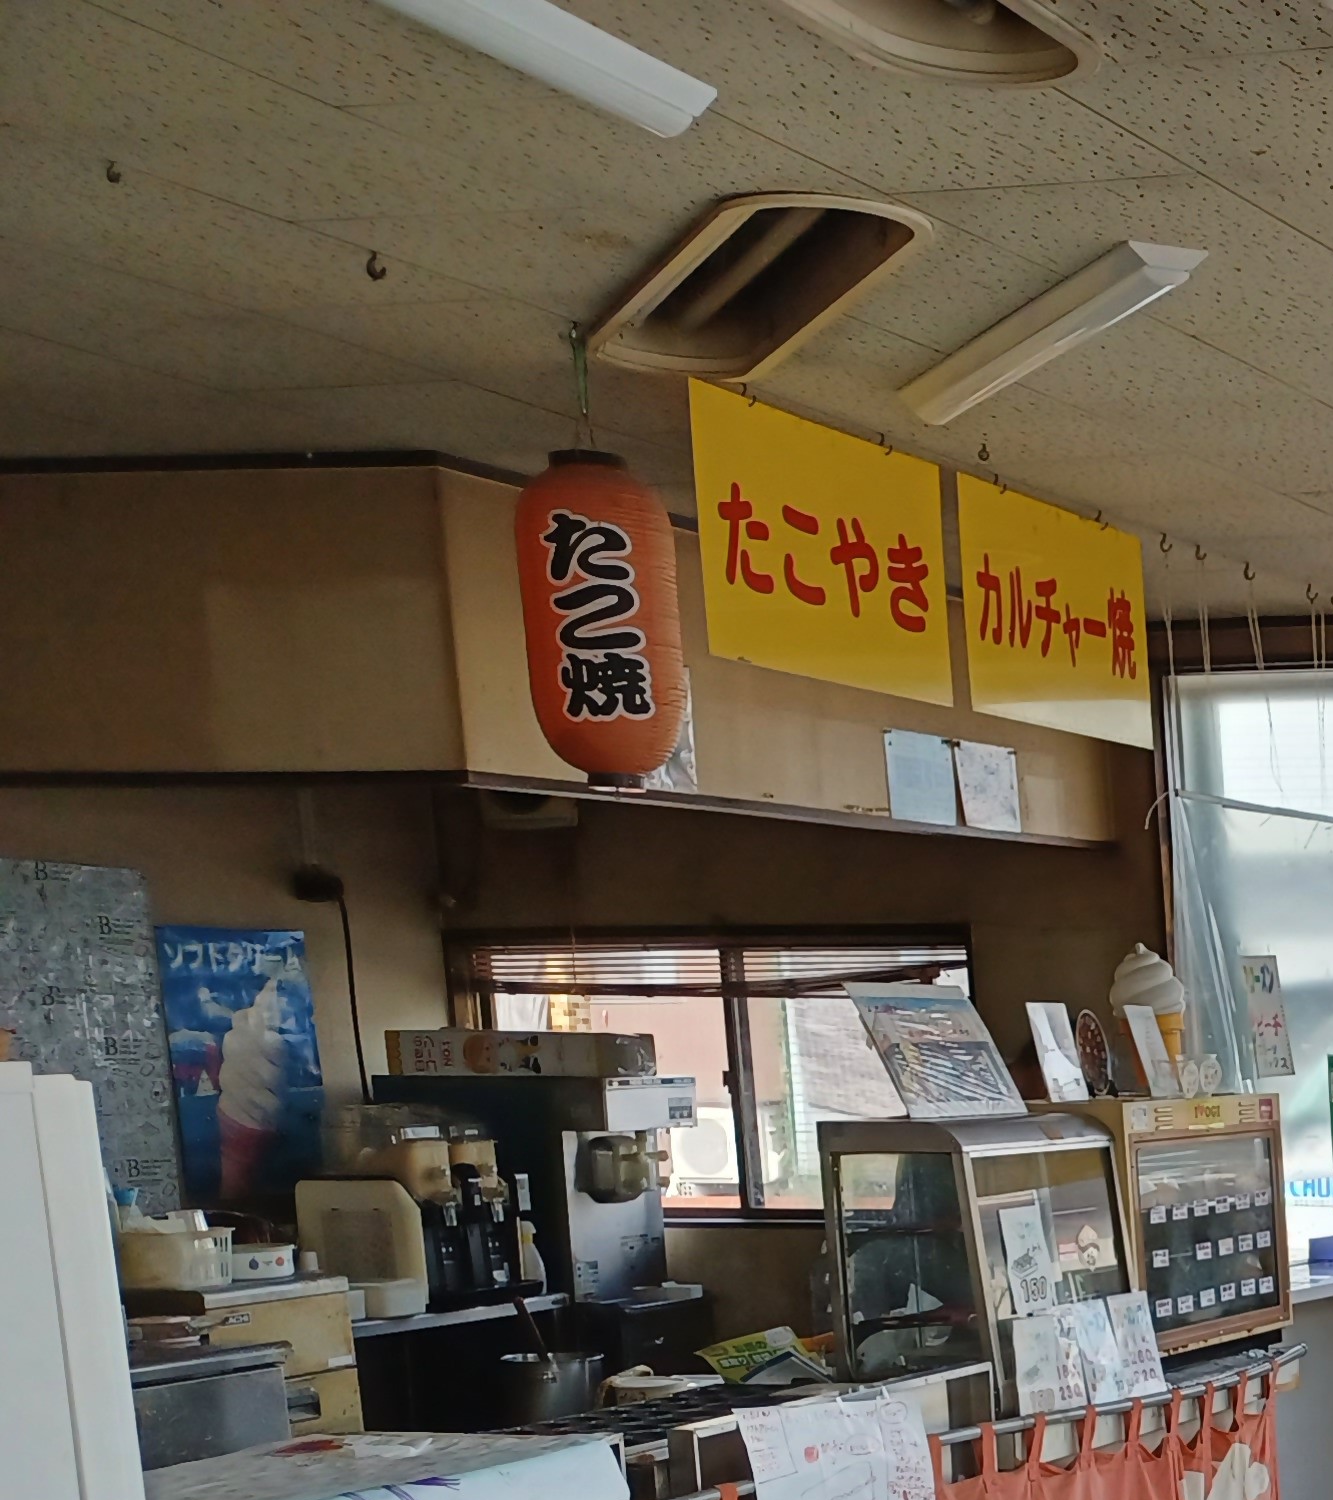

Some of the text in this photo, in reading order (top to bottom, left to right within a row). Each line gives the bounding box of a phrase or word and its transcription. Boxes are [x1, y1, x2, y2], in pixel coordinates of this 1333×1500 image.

[542, 510, 653, 719] たこ焼
[718, 481, 930, 633] たこやき
[975, 552, 1137, 680] カルチャー焼
